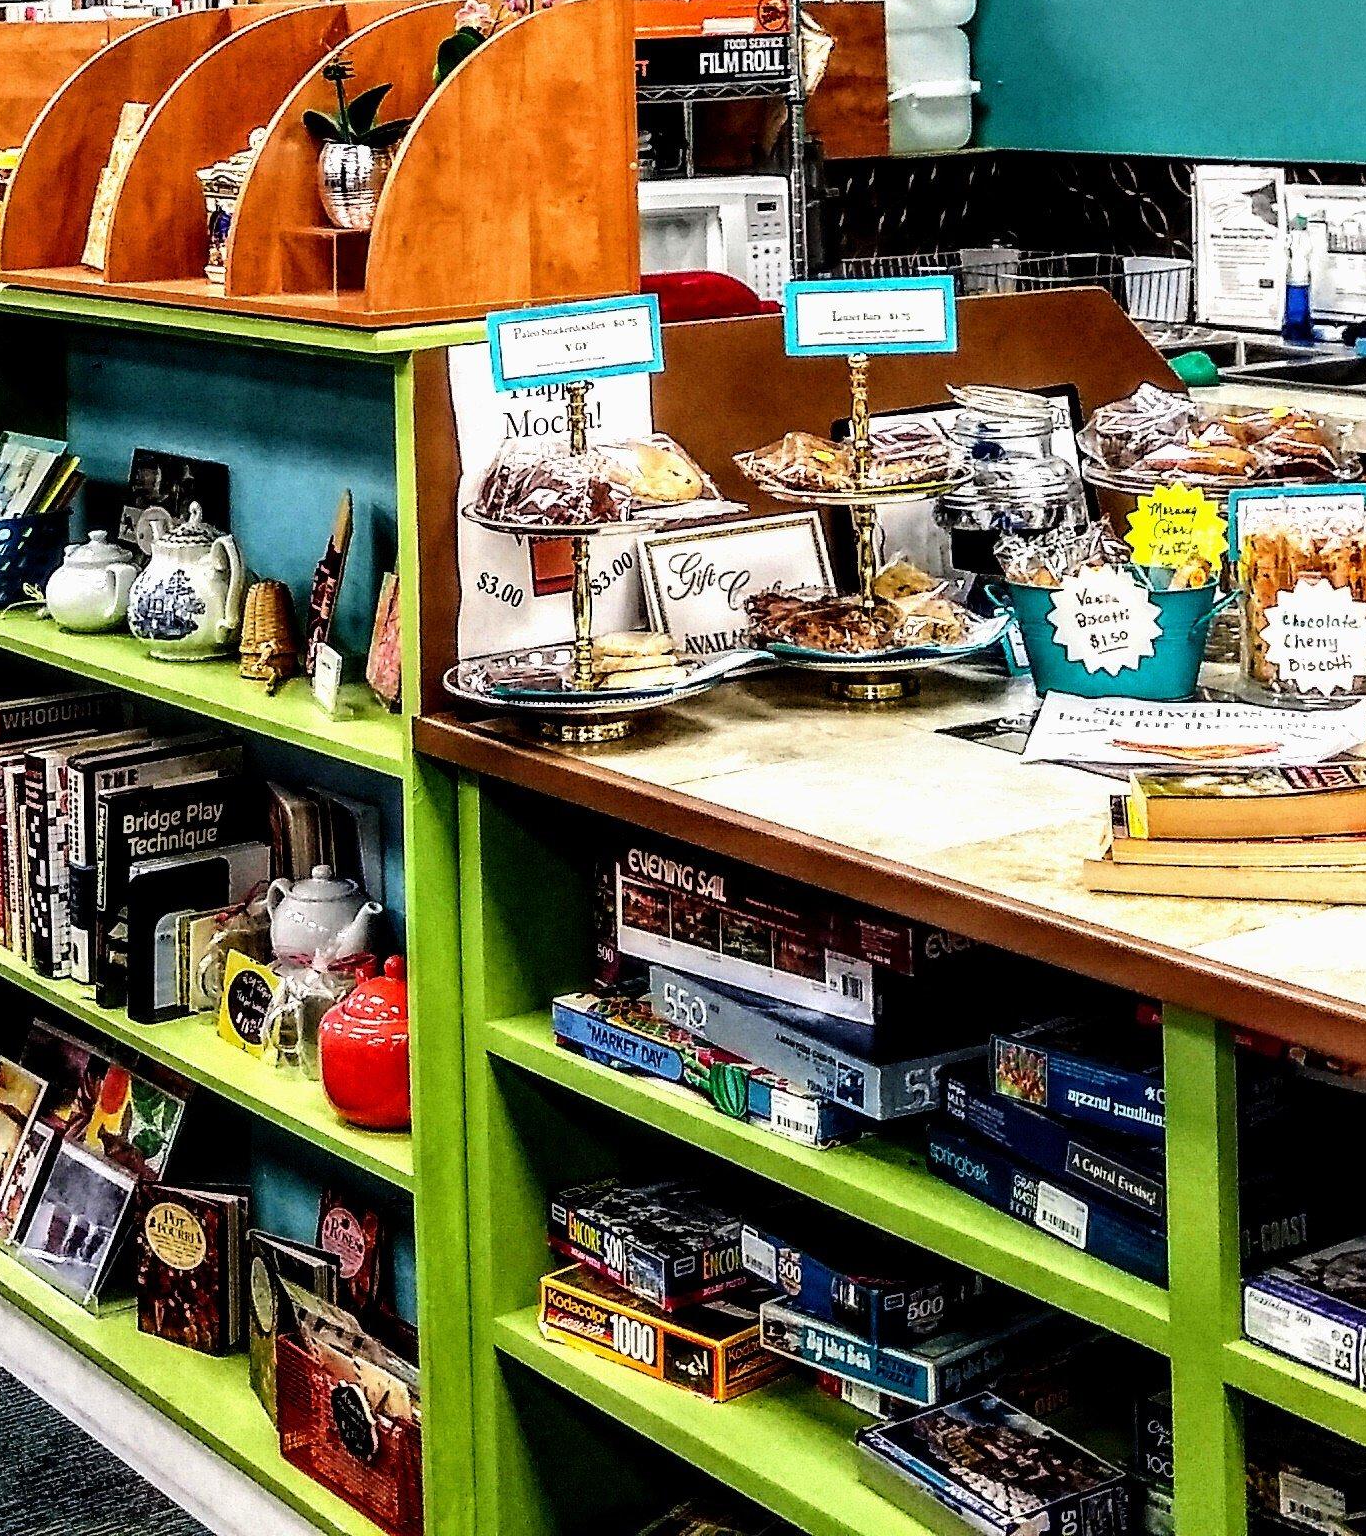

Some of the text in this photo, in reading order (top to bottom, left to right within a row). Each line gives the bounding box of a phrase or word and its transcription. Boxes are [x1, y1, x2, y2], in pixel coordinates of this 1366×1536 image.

[723, 35, 784, 52] FOOD SERVICE
[698, 49, 785, 76] FILM ROLL
[476, 550, 635, 609] $3.00 $3.00
[666, 550, 716, 601] Gift
[1281, 612, 1360, 630] Chocolate
[1283, 632, 1339, 653] Cherry
[1288, 654, 1354, 673] Biscotti
[121, 800, 225, 835] Bridge Play
[128, 825, 218, 857] Technique
[627, 848, 727, 903] EVENING SAIL
[663, 982, 709, 1029] 550
[929, 1141, 989, 1186] springbok
[1071, 1152, 1080, 1167] A
[1081, 1155, 1116, 1182] Capital
[568, 1210, 624, 1273] ENCORE 500
[777, 1259, 803, 1284] 500
[546, 1288, 609, 1326] Kodacolor
[609, 1313, 656, 1366] 1000
[805, 1328, 825, 1362] By
